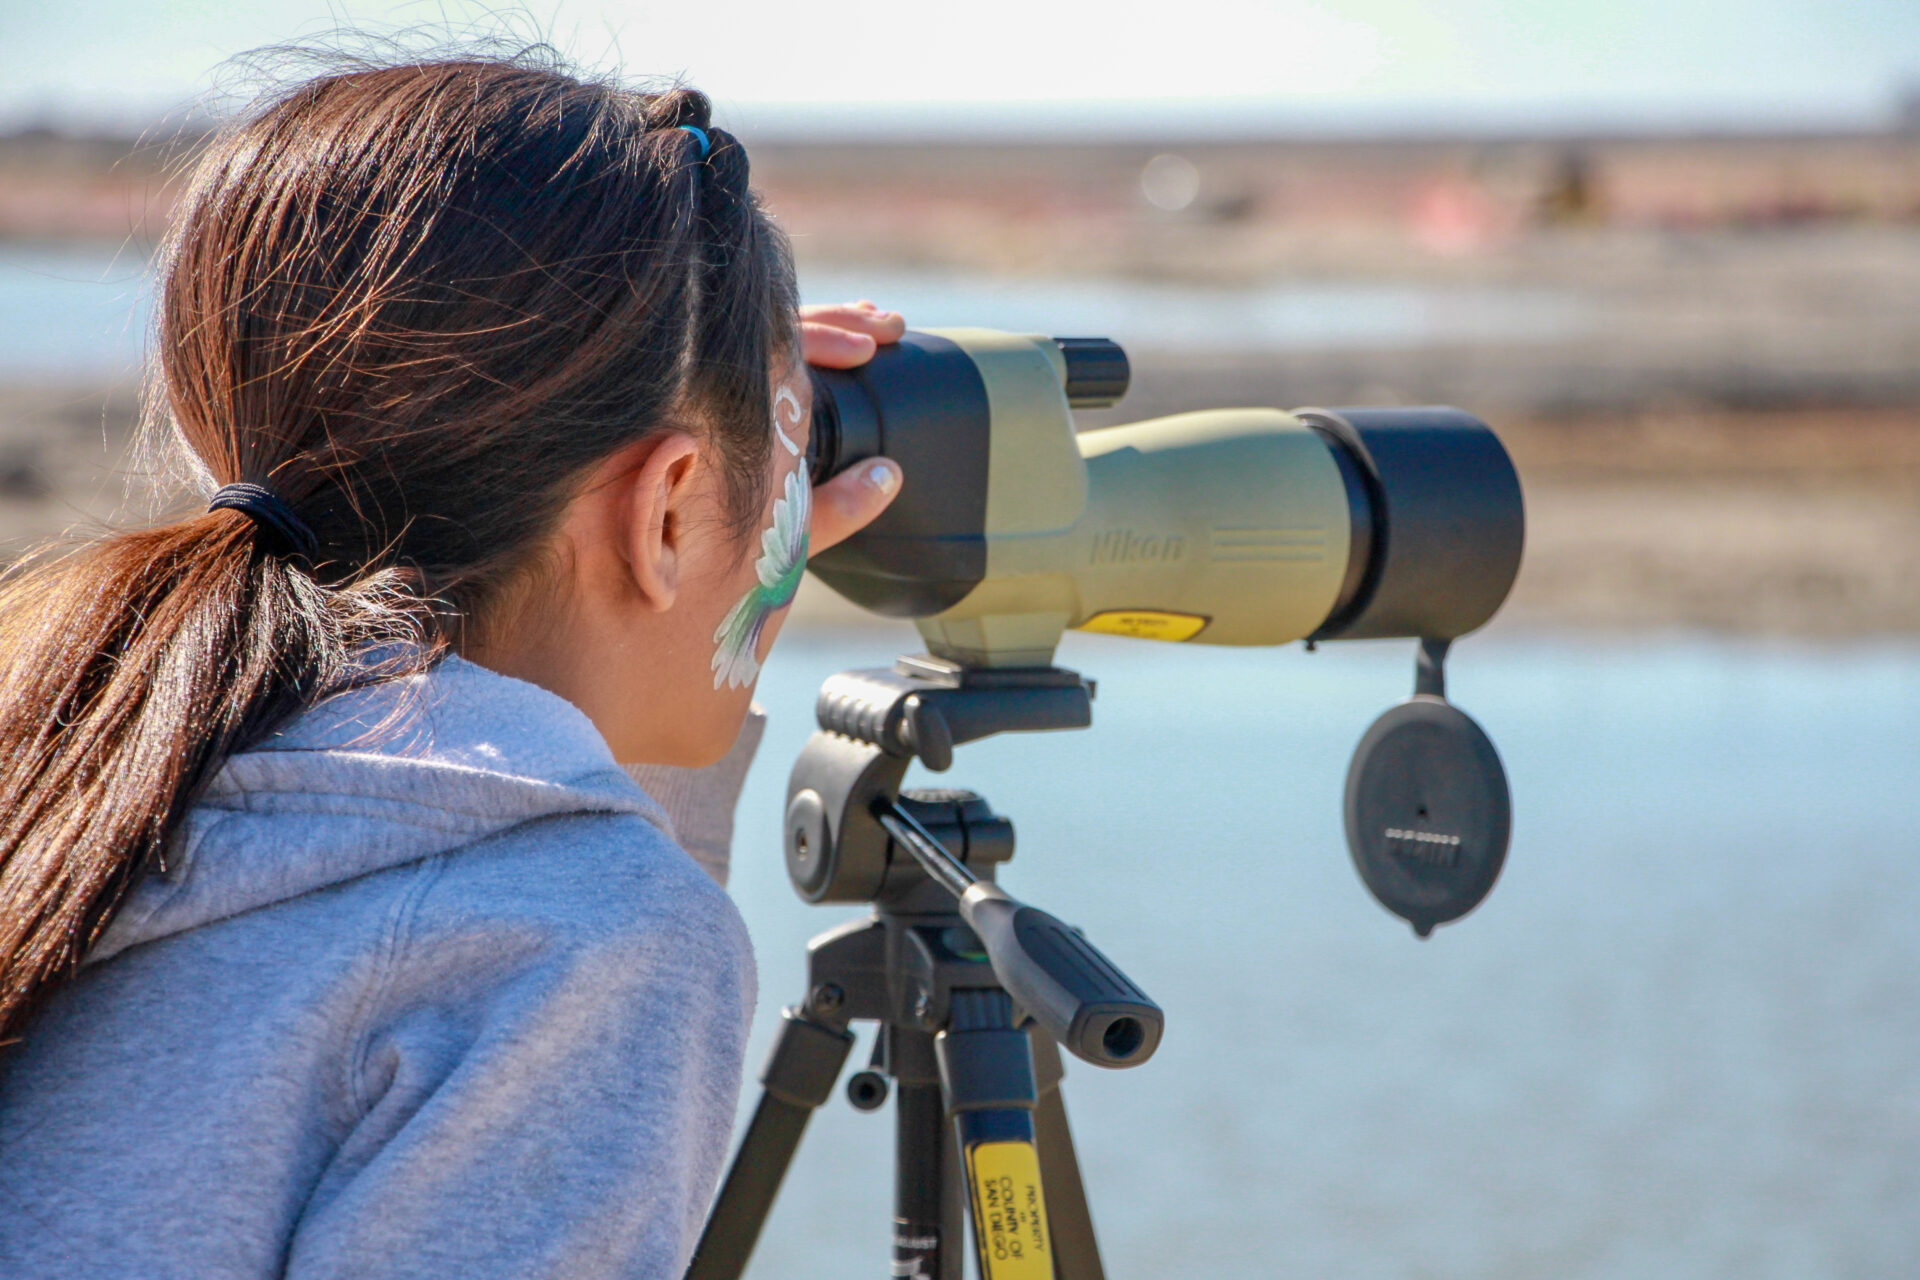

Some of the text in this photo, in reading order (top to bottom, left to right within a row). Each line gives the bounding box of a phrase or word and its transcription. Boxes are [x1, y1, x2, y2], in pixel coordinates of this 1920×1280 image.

[1089, 529, 1184, 564] Nikon
[985, 1180, 1008, 1260] SAN DIEGO
[1000, 1176, 1023, 1259] COUNTY OF
